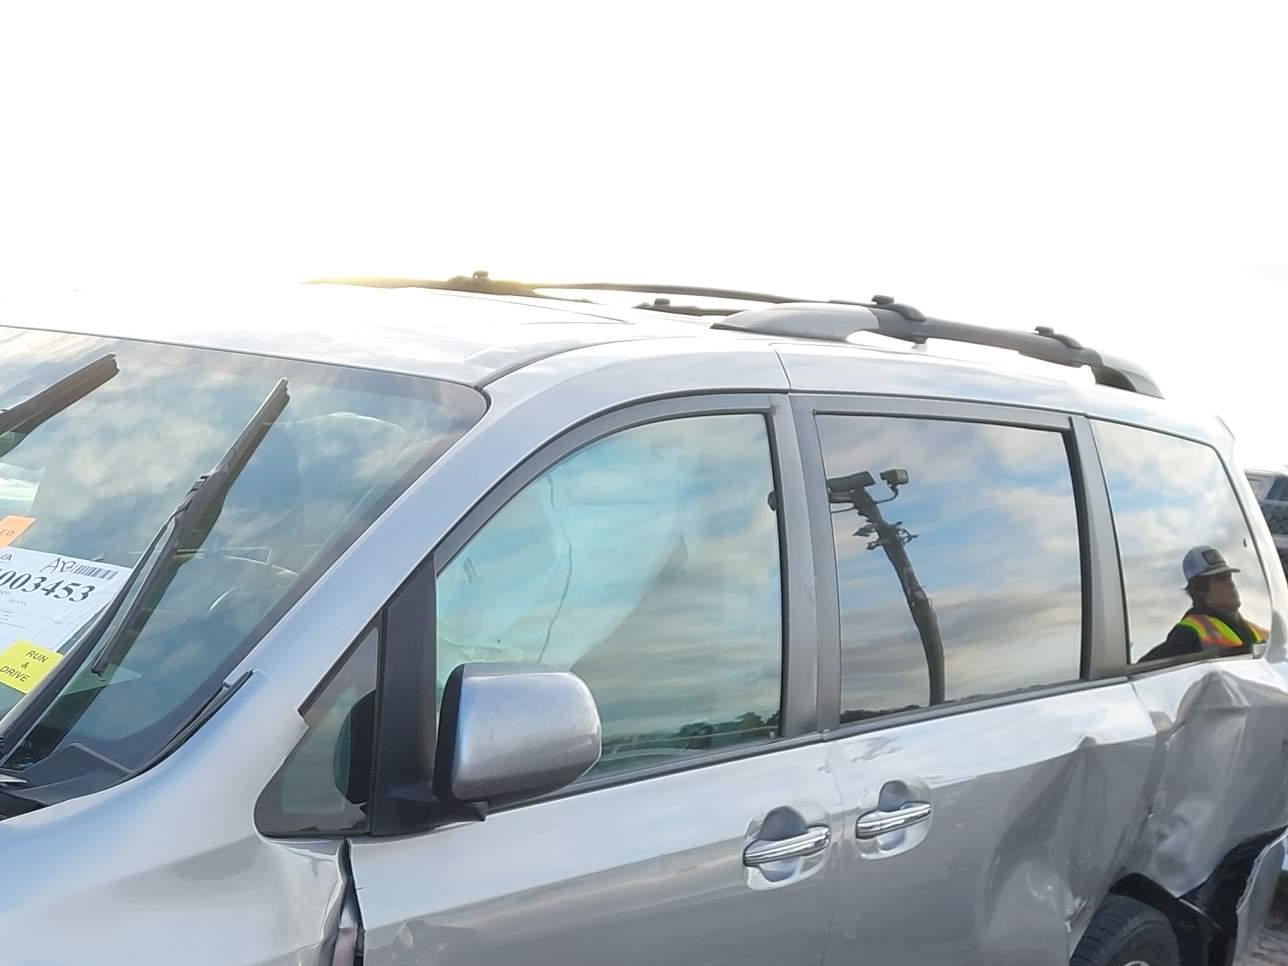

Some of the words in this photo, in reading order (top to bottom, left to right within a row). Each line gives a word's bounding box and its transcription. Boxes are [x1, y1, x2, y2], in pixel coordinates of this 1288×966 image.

[25, 649, 49, 663] RUN
[20, 660, 30, 670] &
[0, 664, 31, 683] DRIVE
